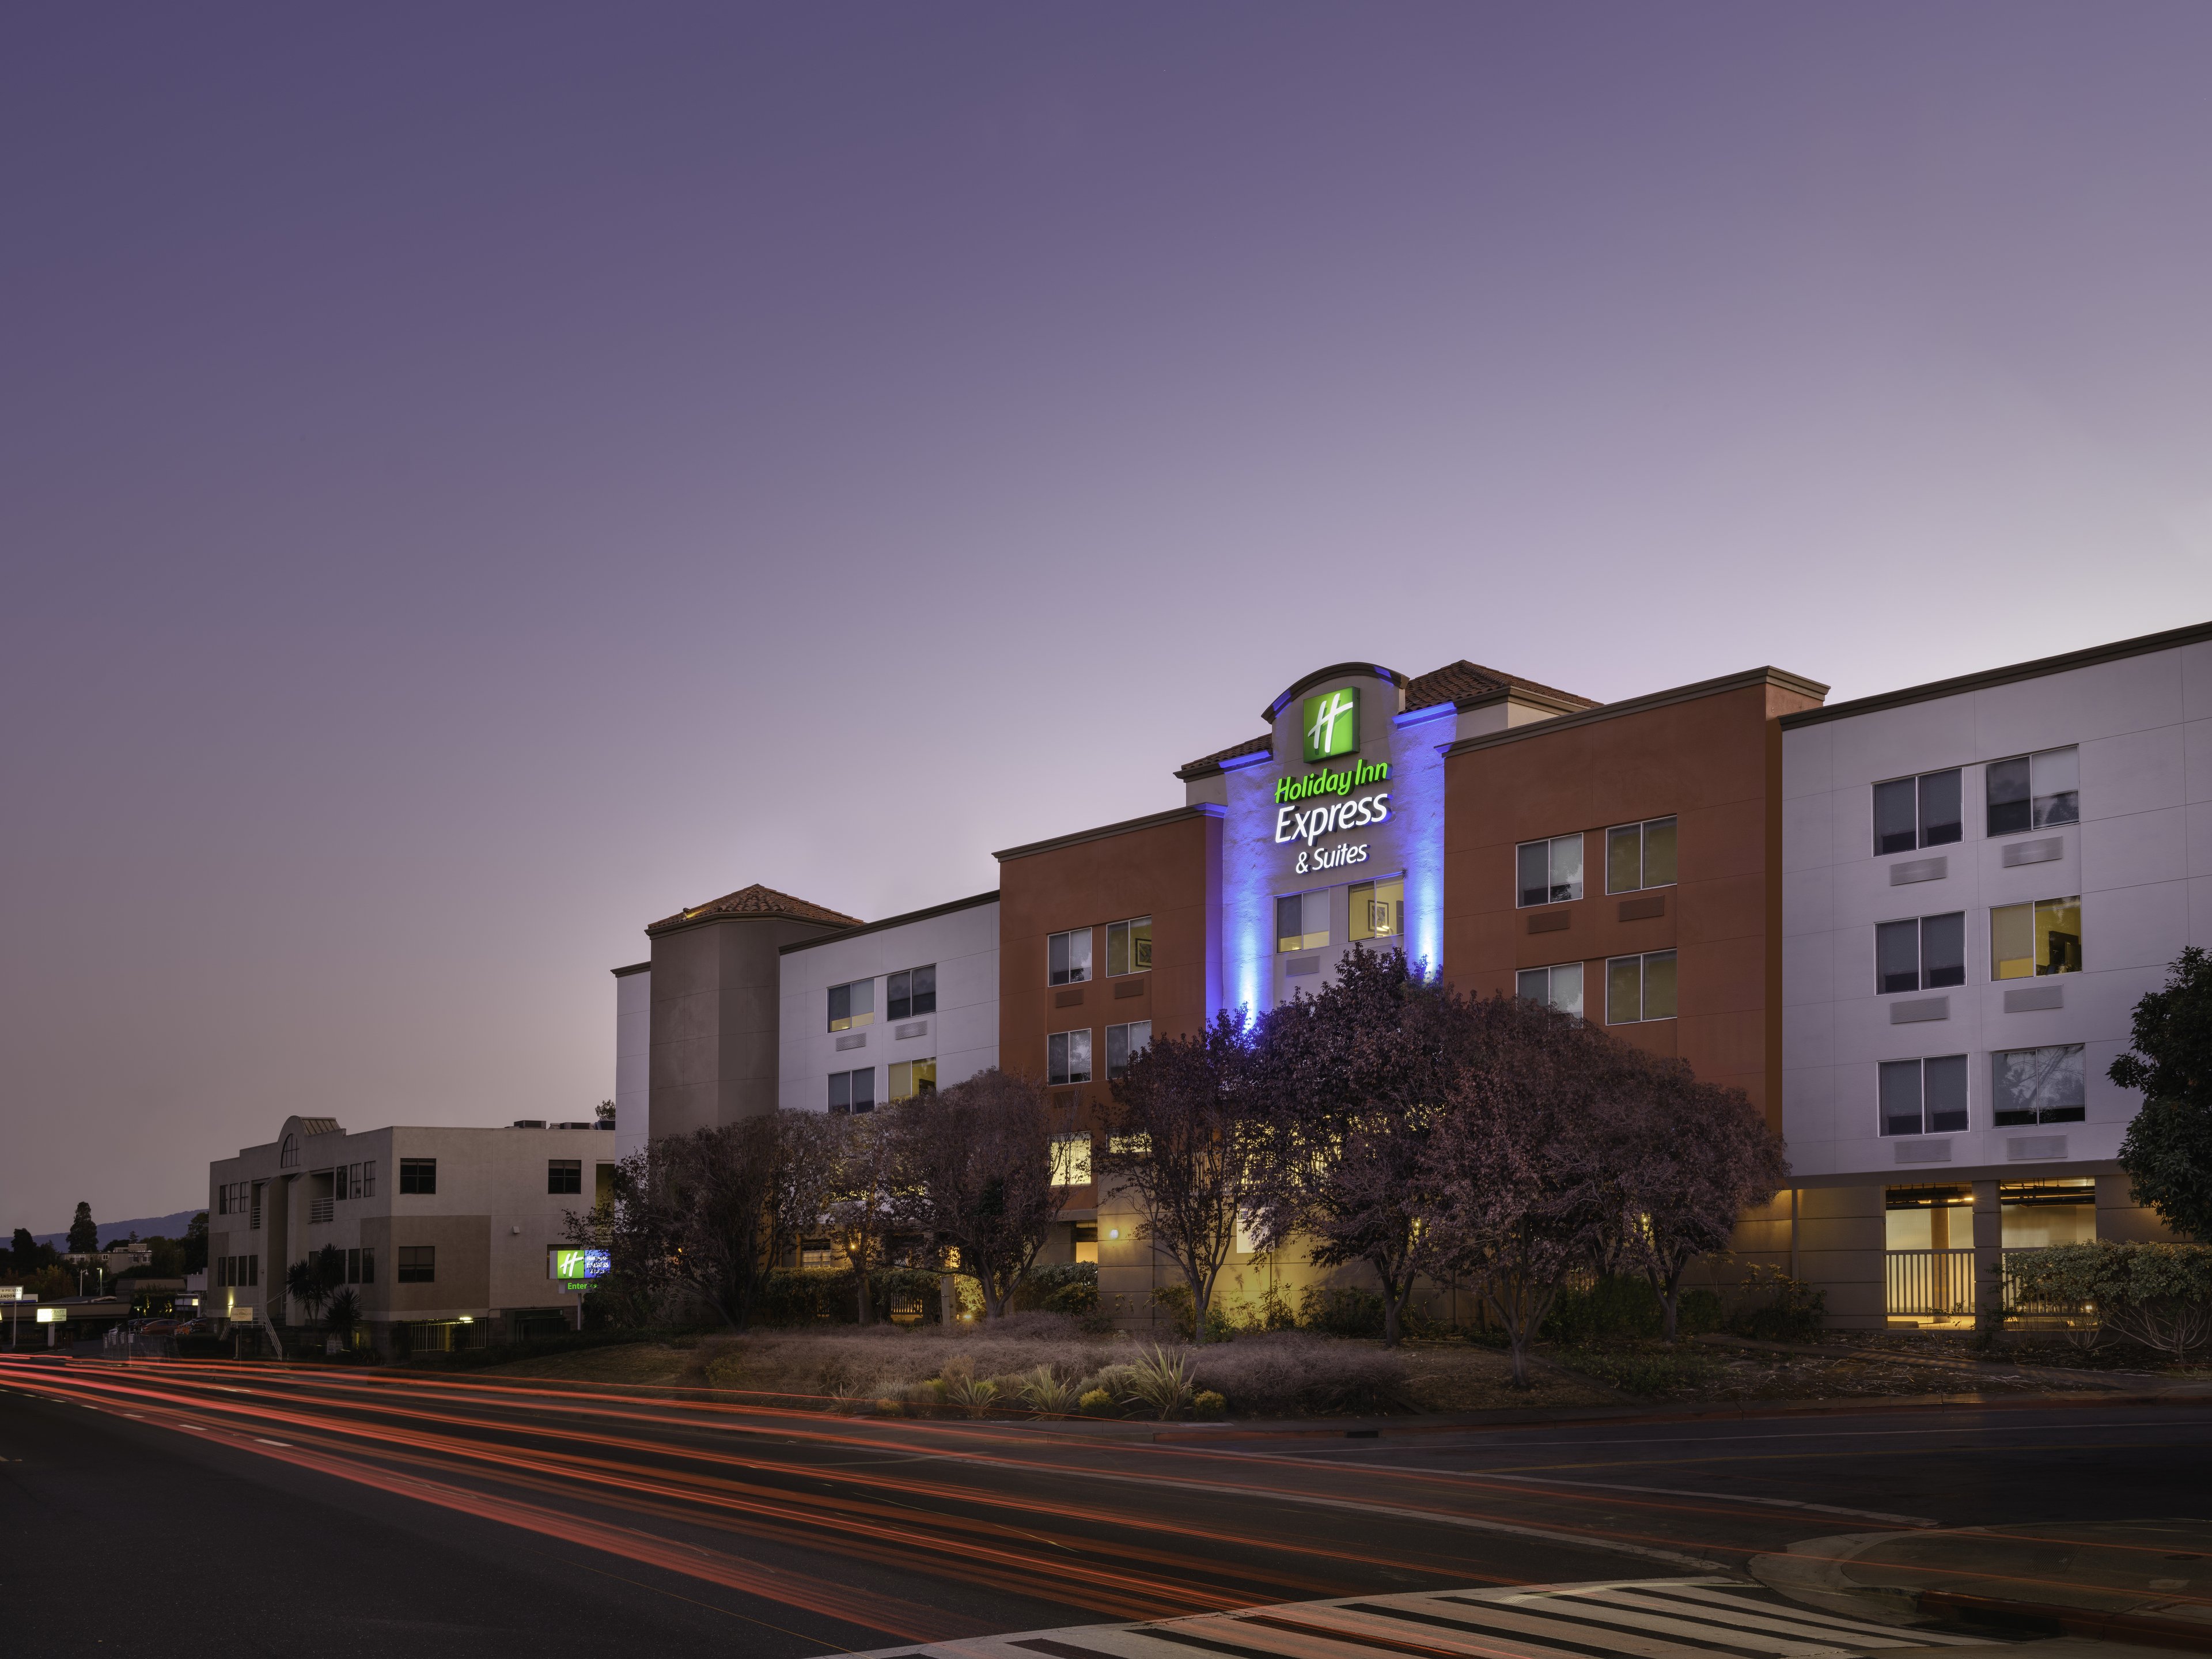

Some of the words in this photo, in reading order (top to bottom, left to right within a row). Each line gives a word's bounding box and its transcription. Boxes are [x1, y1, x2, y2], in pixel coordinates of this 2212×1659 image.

[1274, 768, 1352, 804] Holiday
[1355, 759, 1388, 785] Inn
[1275, 793, 1388, 846] Express
[1296, 851, 1309, 874] &
[1312, 843, 1368, 870] Suites
